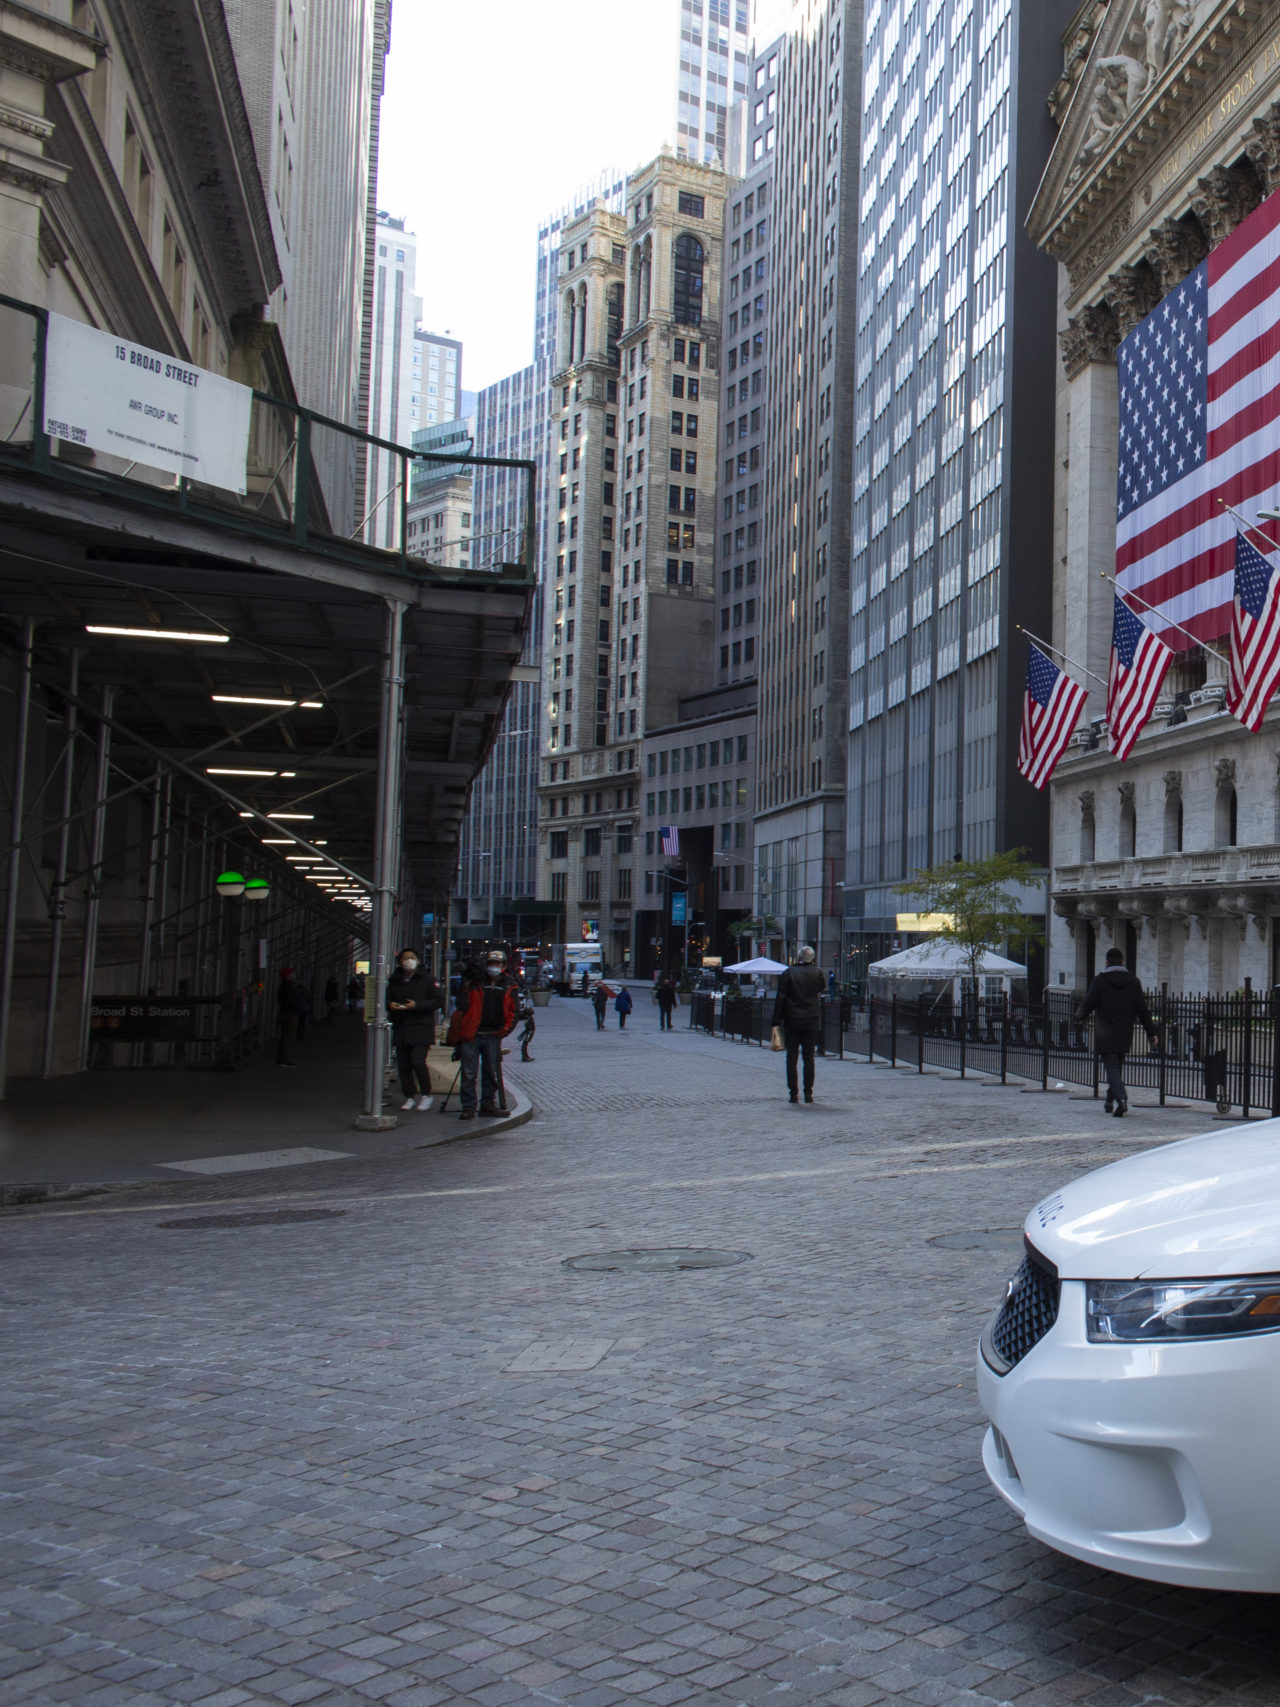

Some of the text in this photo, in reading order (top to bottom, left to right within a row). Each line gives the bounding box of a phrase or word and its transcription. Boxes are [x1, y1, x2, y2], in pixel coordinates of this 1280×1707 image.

[1158, 150, 1181, 189] NEW
[1184, 111, 1214, 159] YORK
[1219, 64, 1257, 120] STOCK
[115, 345, 199, 388] 15 BROAD STREET
[144, 404, 165, 420] GROUP
[91, 1006, 190, 1017] Broad St Station
